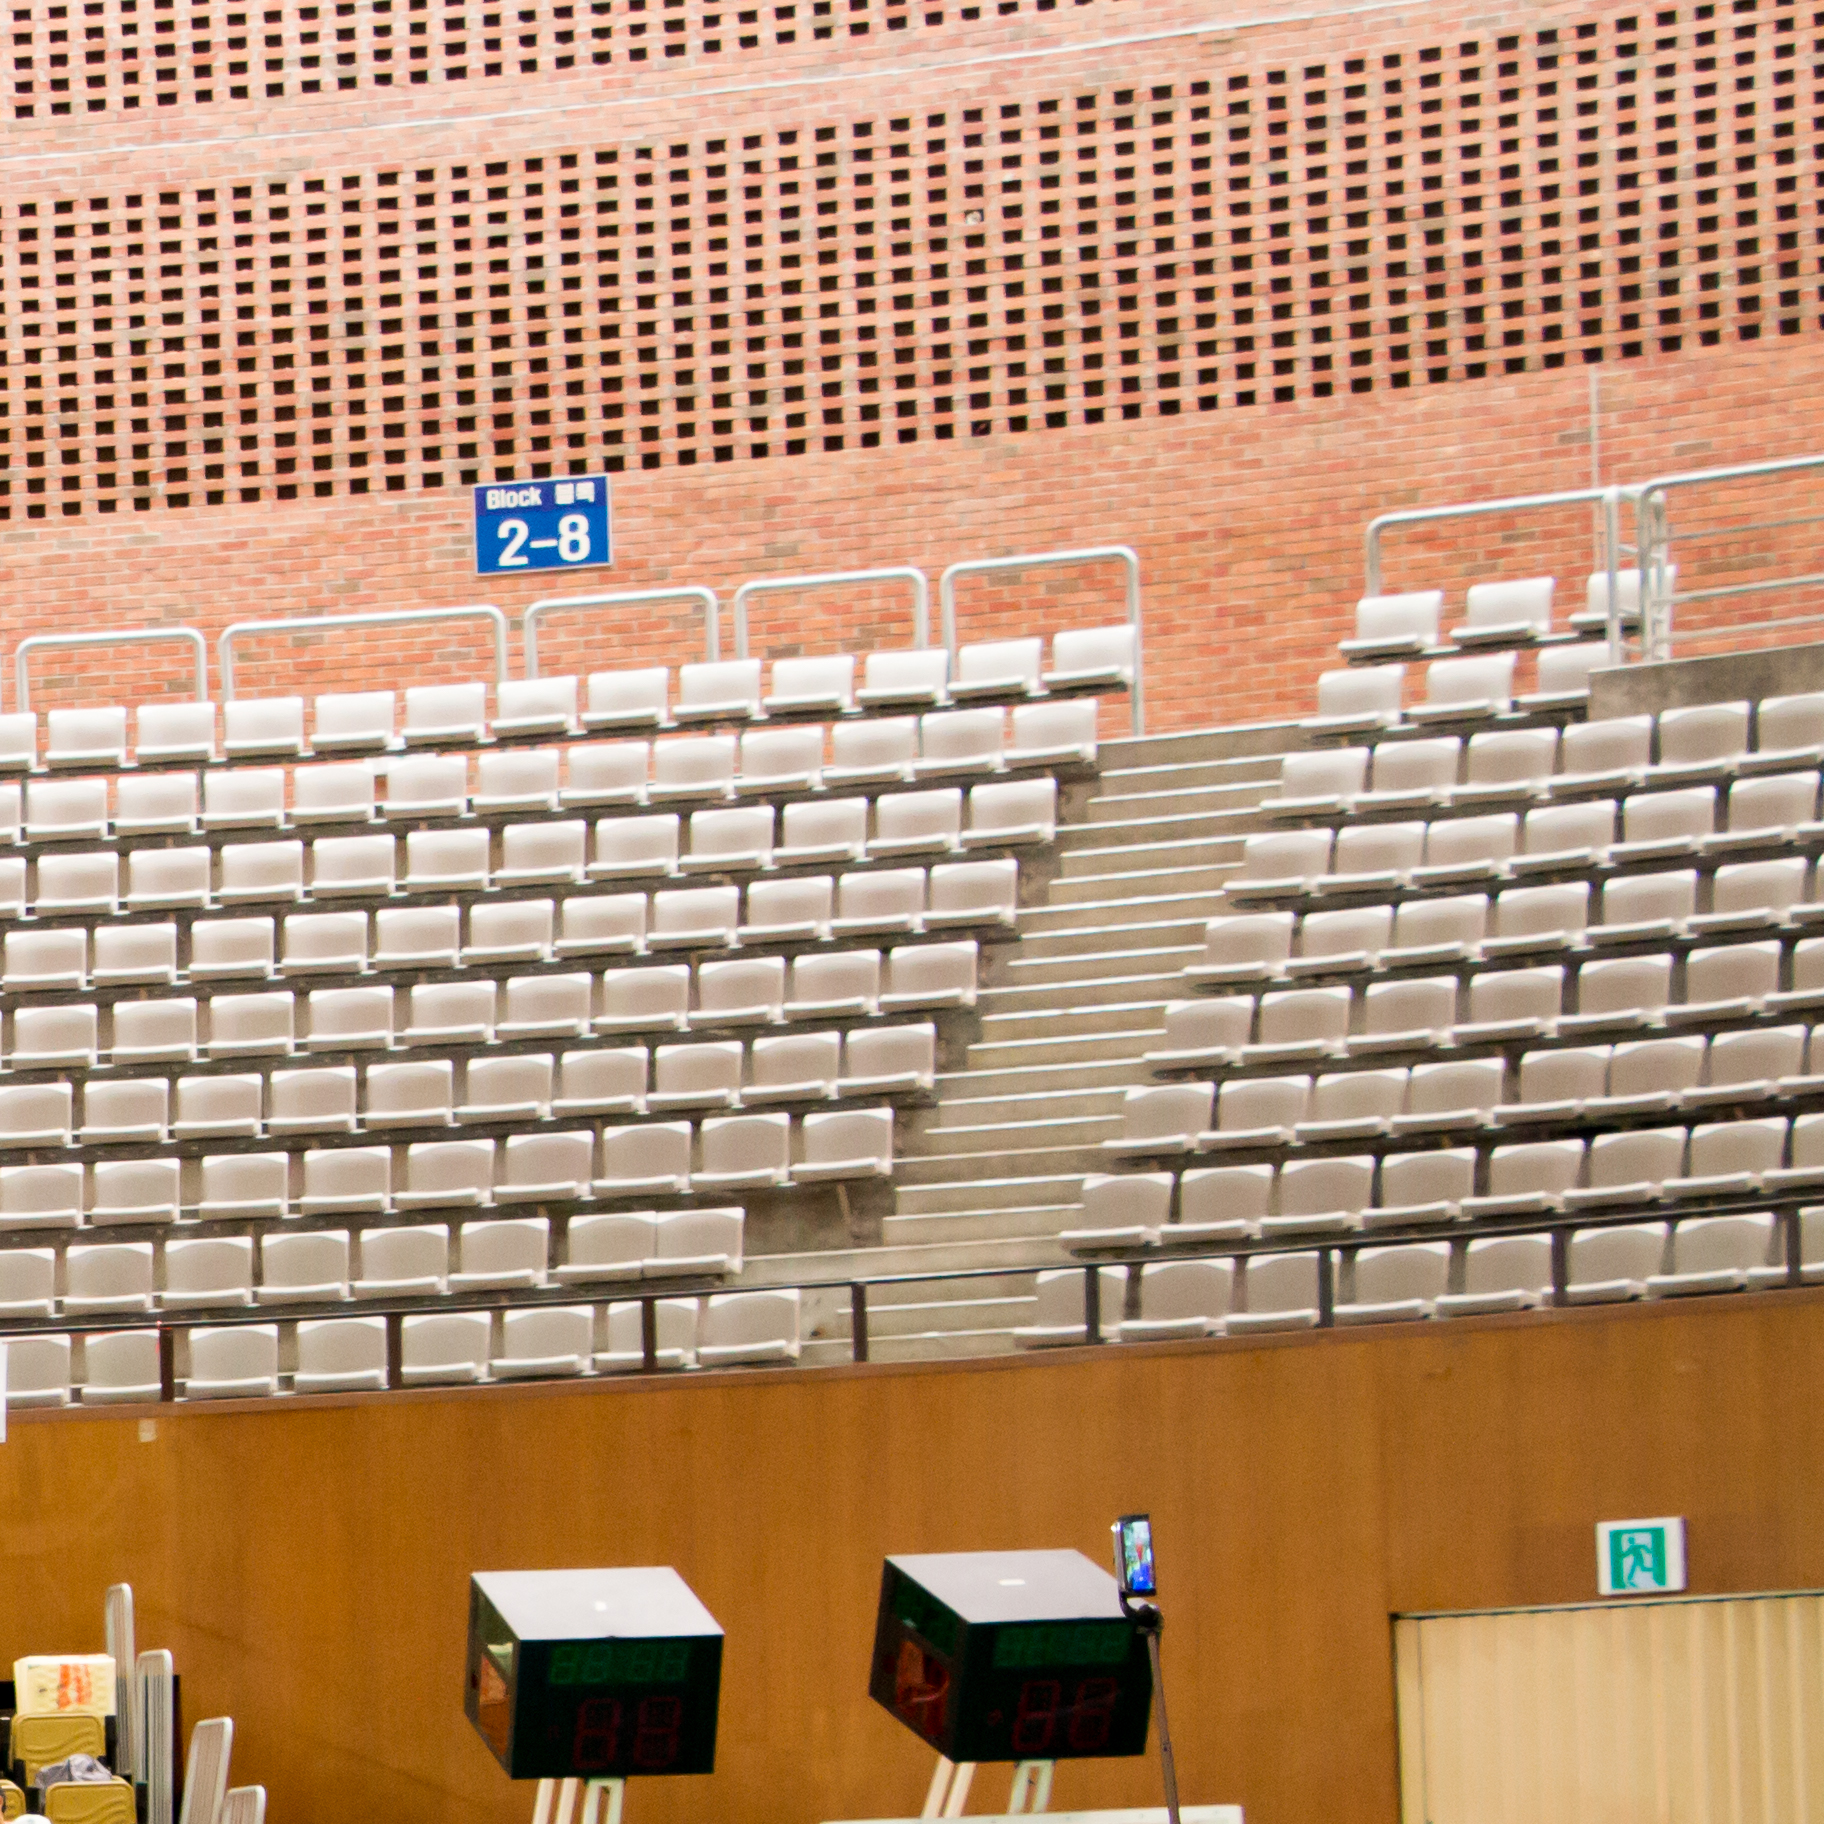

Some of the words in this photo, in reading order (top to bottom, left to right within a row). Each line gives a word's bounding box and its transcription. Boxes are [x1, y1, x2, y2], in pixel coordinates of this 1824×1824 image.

[486, 486, 542, 510] Block
[554, 481, 595, 505] 블록
[497, 513, 591, 567] 2-8
